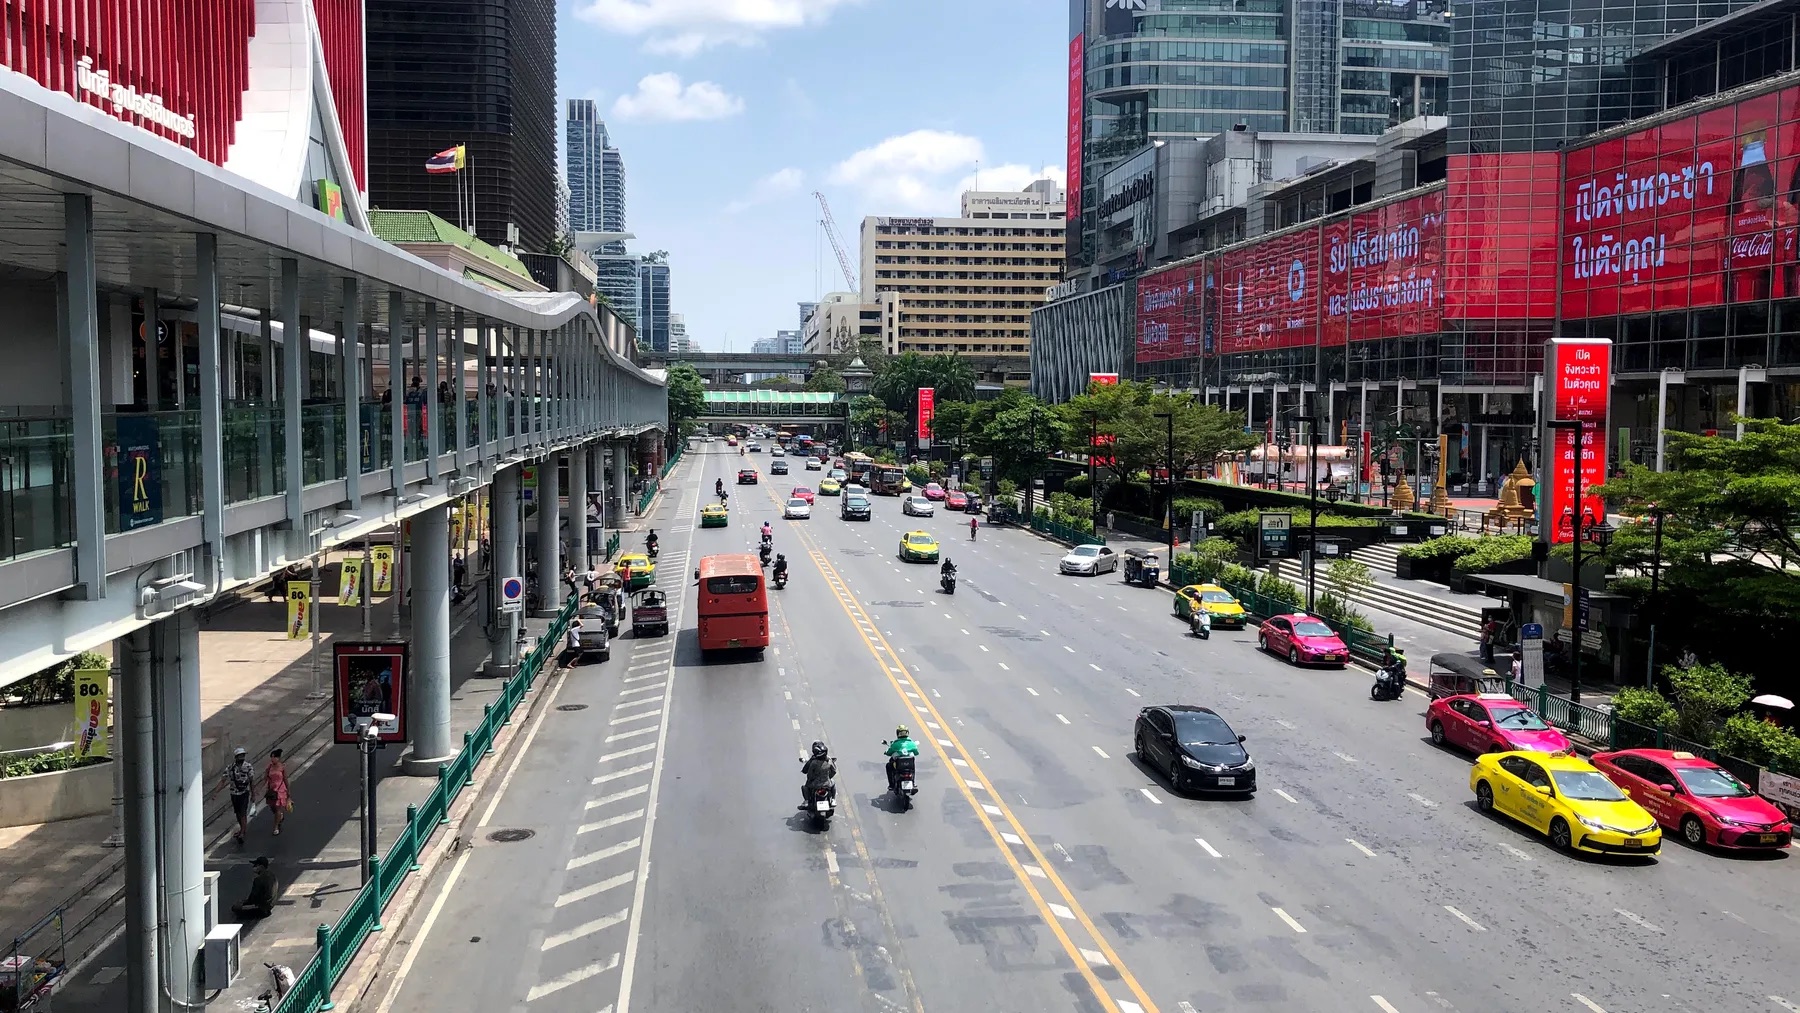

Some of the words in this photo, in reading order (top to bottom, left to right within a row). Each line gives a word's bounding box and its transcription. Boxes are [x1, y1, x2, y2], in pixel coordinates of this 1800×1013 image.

[77, 55, 110, 100] บิ๊กซี
[109, 83, 195, 139] ซูเปอร์เซ็นเตอร์
[1575, 152, 1714, 223] เปิดจังหวะซ่า
[1572, 233, 1665, 286] ในตัวคุณ
[1565, 363, 1600, 374] จังหวะซ่า
[1575, 349, 1590, 360] เปิด
[1564, 377, 1600, 392] ในตัวคุณ
[133, 456, 148, 501] R
[133, 500, 150, 514] WALK
